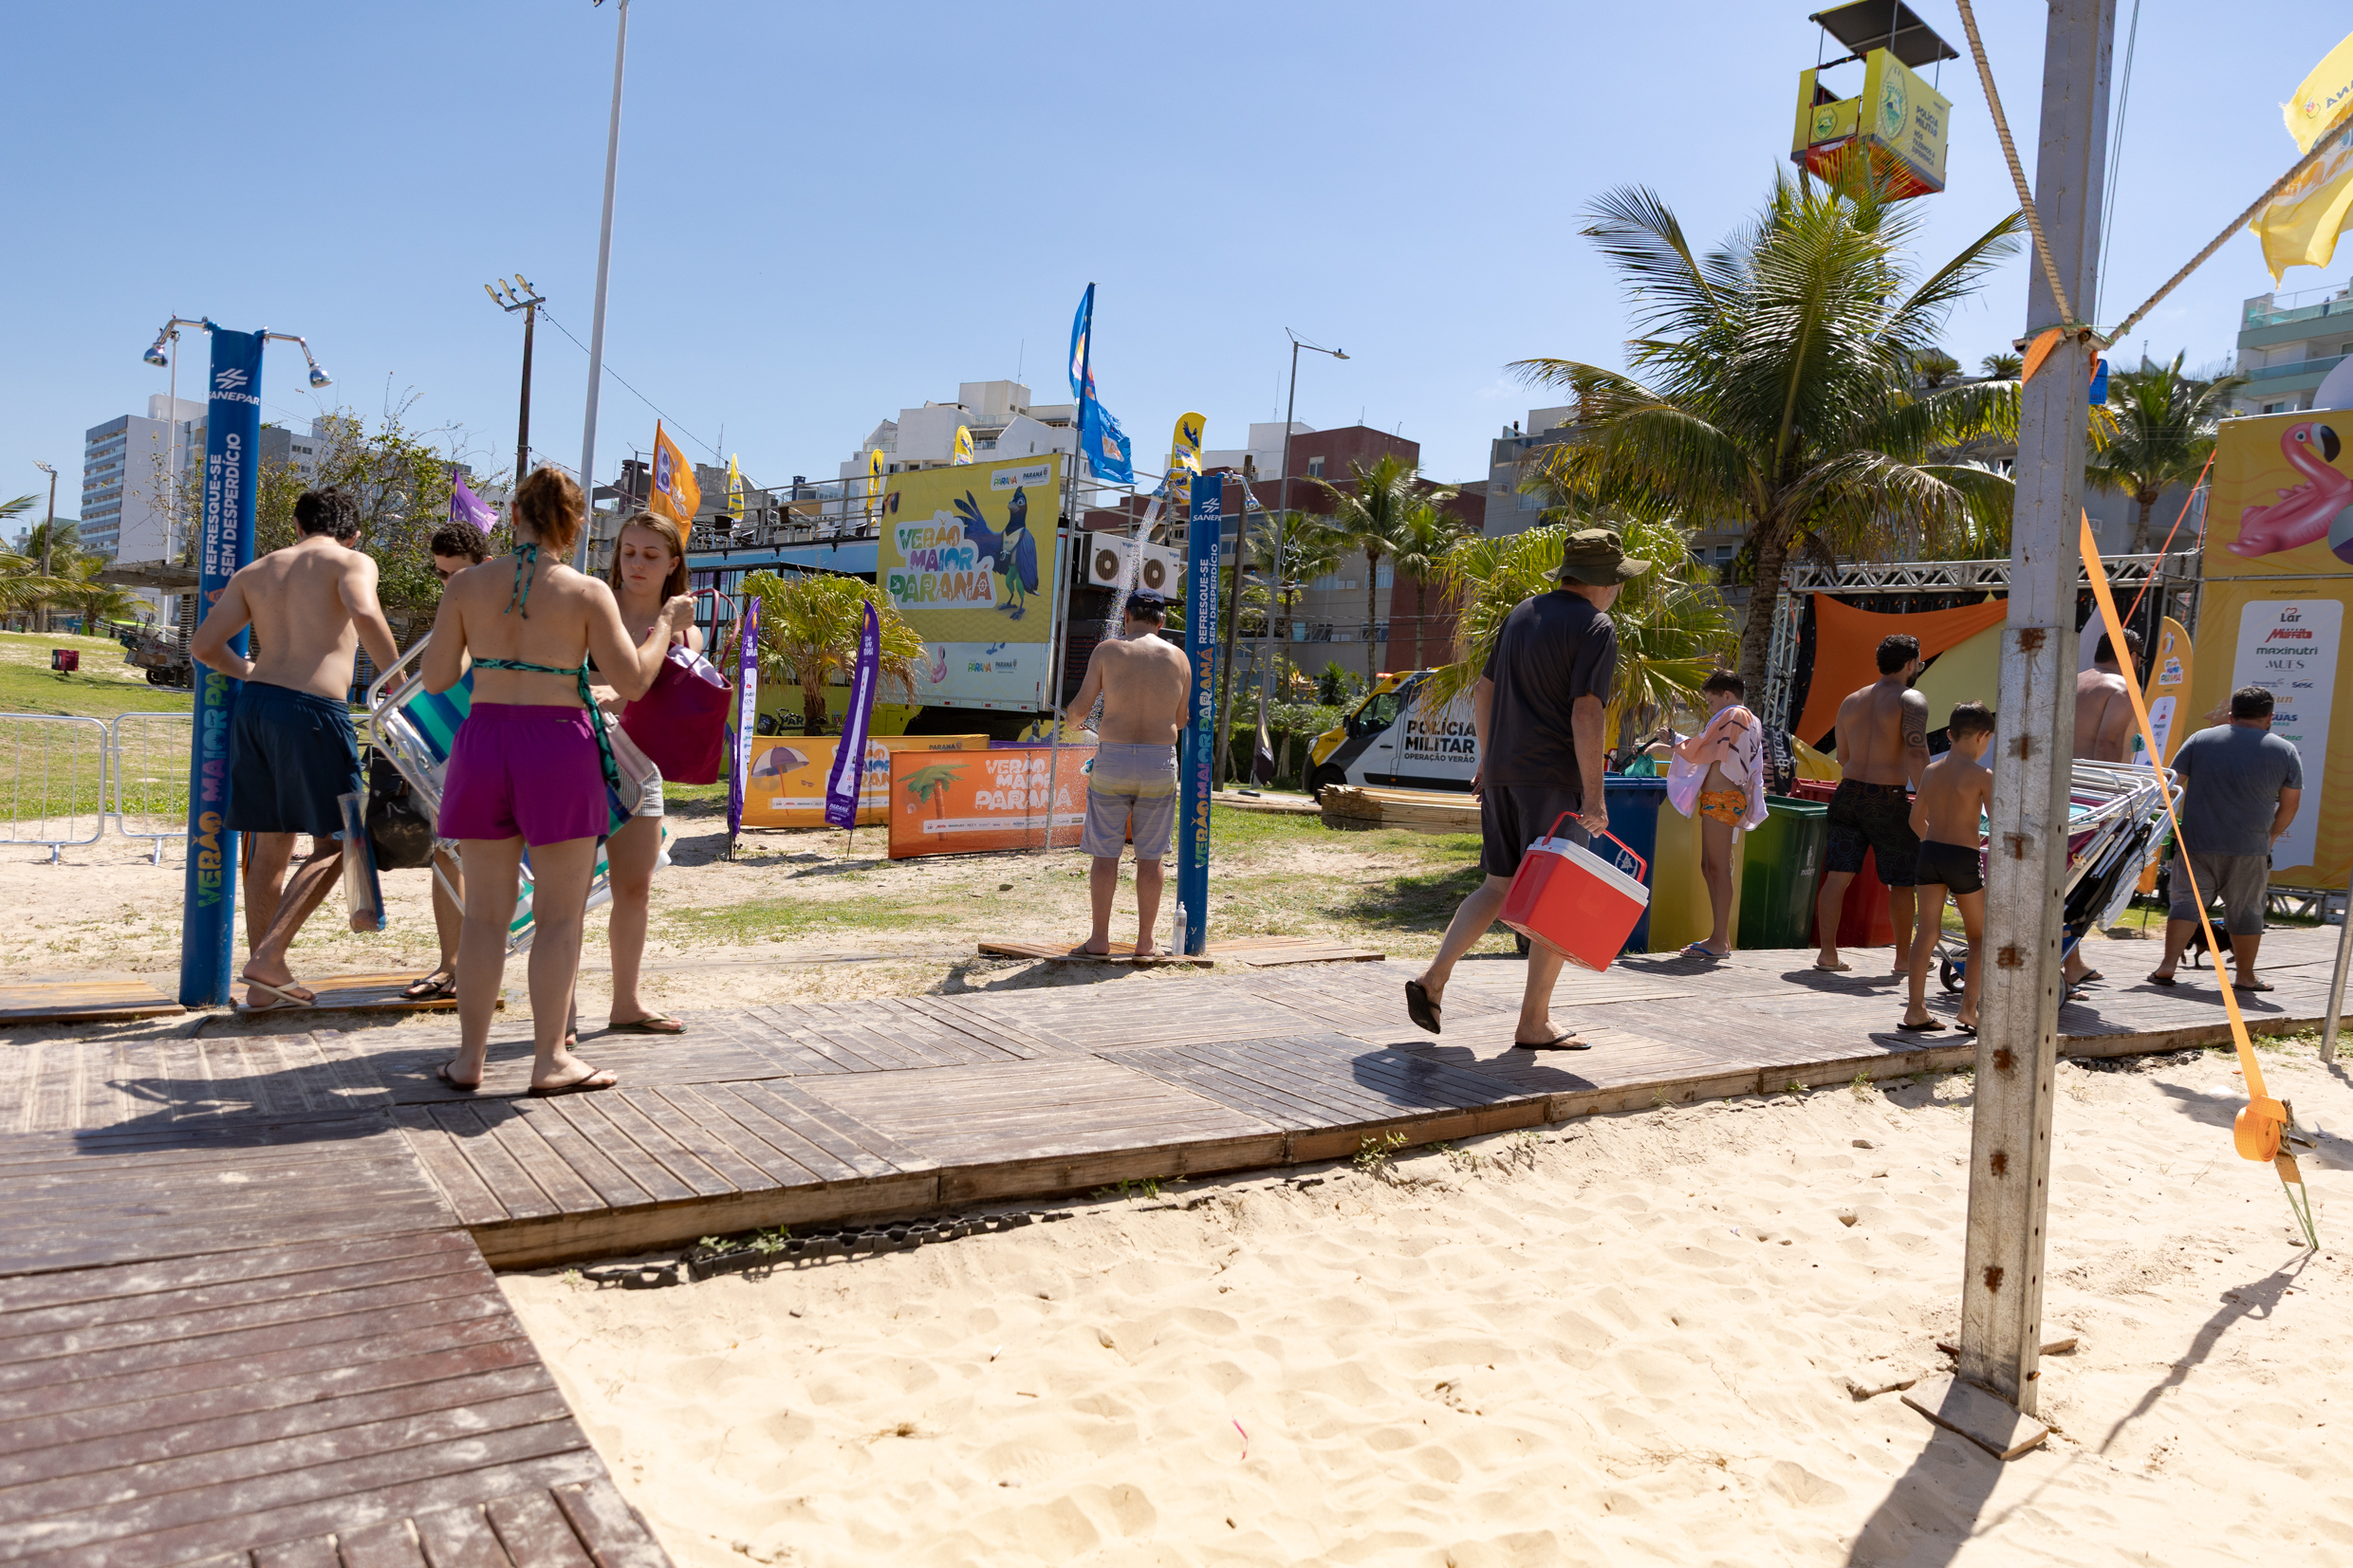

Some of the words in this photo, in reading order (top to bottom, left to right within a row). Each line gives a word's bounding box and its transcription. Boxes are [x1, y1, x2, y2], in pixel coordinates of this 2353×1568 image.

[1916, 115, 1938, 138] MILITAR
[1917, 104, 1938, 129] POLÍCIA
[222, 433, 242, 542] DESPERDÍCIO
[993, 475, 1018, 487] PARANÁ
[205, 453, 222, 576] REFRESQUE-SE
[899, 517, 960, 550] VERÃO
[220, 544, 236, 577] SEM
[910, 546, 973, 572] MAIOR
[890, 563, 992, 603] PARANÁ
[1208, 543, 1218, 621] DESPERDÍCIO
[1198, 558, 1209, 644] REFRESQUE-SE
[2280, 613, 2302, 622] Lar
[2255, 646, 2318, 655] maxinutri
[968, 662, 991, 673] PARANÁ
[1196, 647, 1214, 731] PARANÁ
[1406, 716, 1477, 737] POLÍCIA
[201, 709, 228, 802] MAIOR
[1404, 736, 1475, 754] MILITAR
[1404, 752, 1446, 763] OPERAÇÃO
[1448, 754, 1475, 764] VERÃO
[985, 753, 1046, 775] VERÃO
[1196, 733, 1213, 799] MAIOR
[975, 784, 1073, 810] PARANÁ
[1190, 800, 1210, 869] VERÃO
[192, 810, 223, 908] VERÃO
